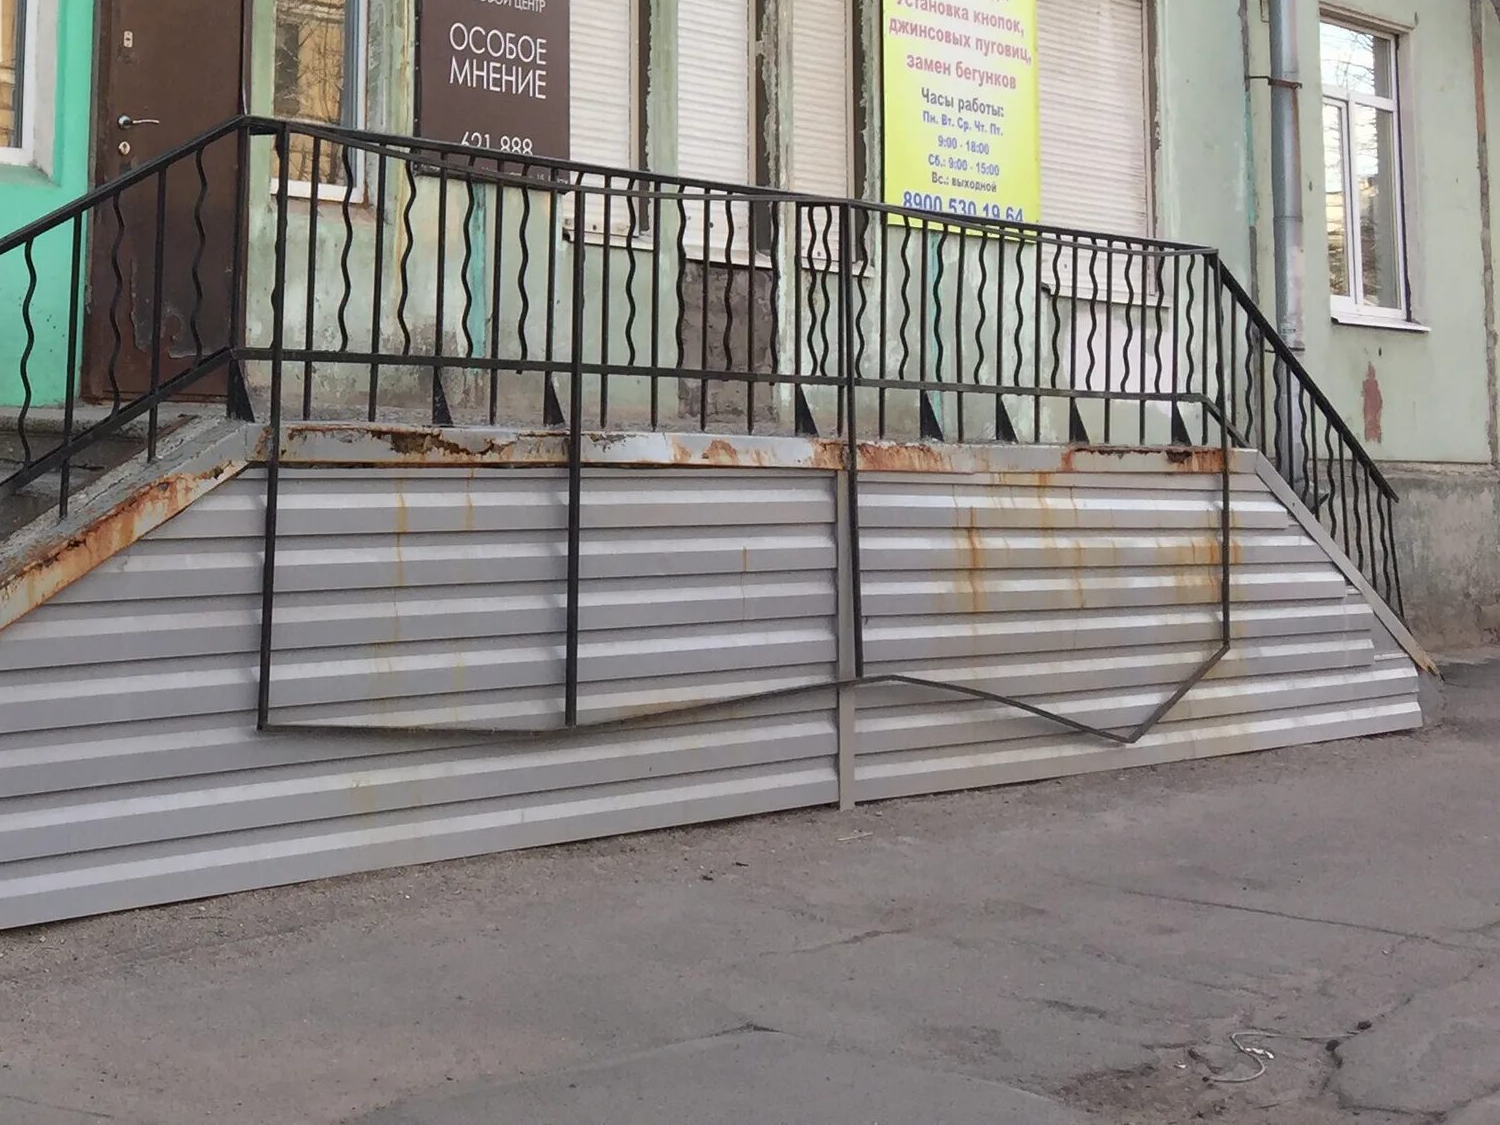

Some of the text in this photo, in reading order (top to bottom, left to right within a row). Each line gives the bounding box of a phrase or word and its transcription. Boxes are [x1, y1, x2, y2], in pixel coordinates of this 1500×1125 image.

[973, 11, 1024, 37] кнопок,
[449, 21, 547, 66] ОСОБОЕ
[889, 18, 1032, 66] джинсовых пуговиц,
[449, 56, 547, 100] МНЕНИЕ
[906, 54, 1017, 89] замен бегунков
[921, 86, 1004, 117] Часы работы:
[937, 135, 958, 150] 9:00
[965, 140, 990, 155] 18:00
[948, 157, 968, 172] 9:00
[975, 162, 1000, 177] 15:00
[952, 177, 997, 193] выходной
[903, 191, 943, 213] 8900
[948, 198, 977, 216] 530
[983, 202, 1000, 220] 19
